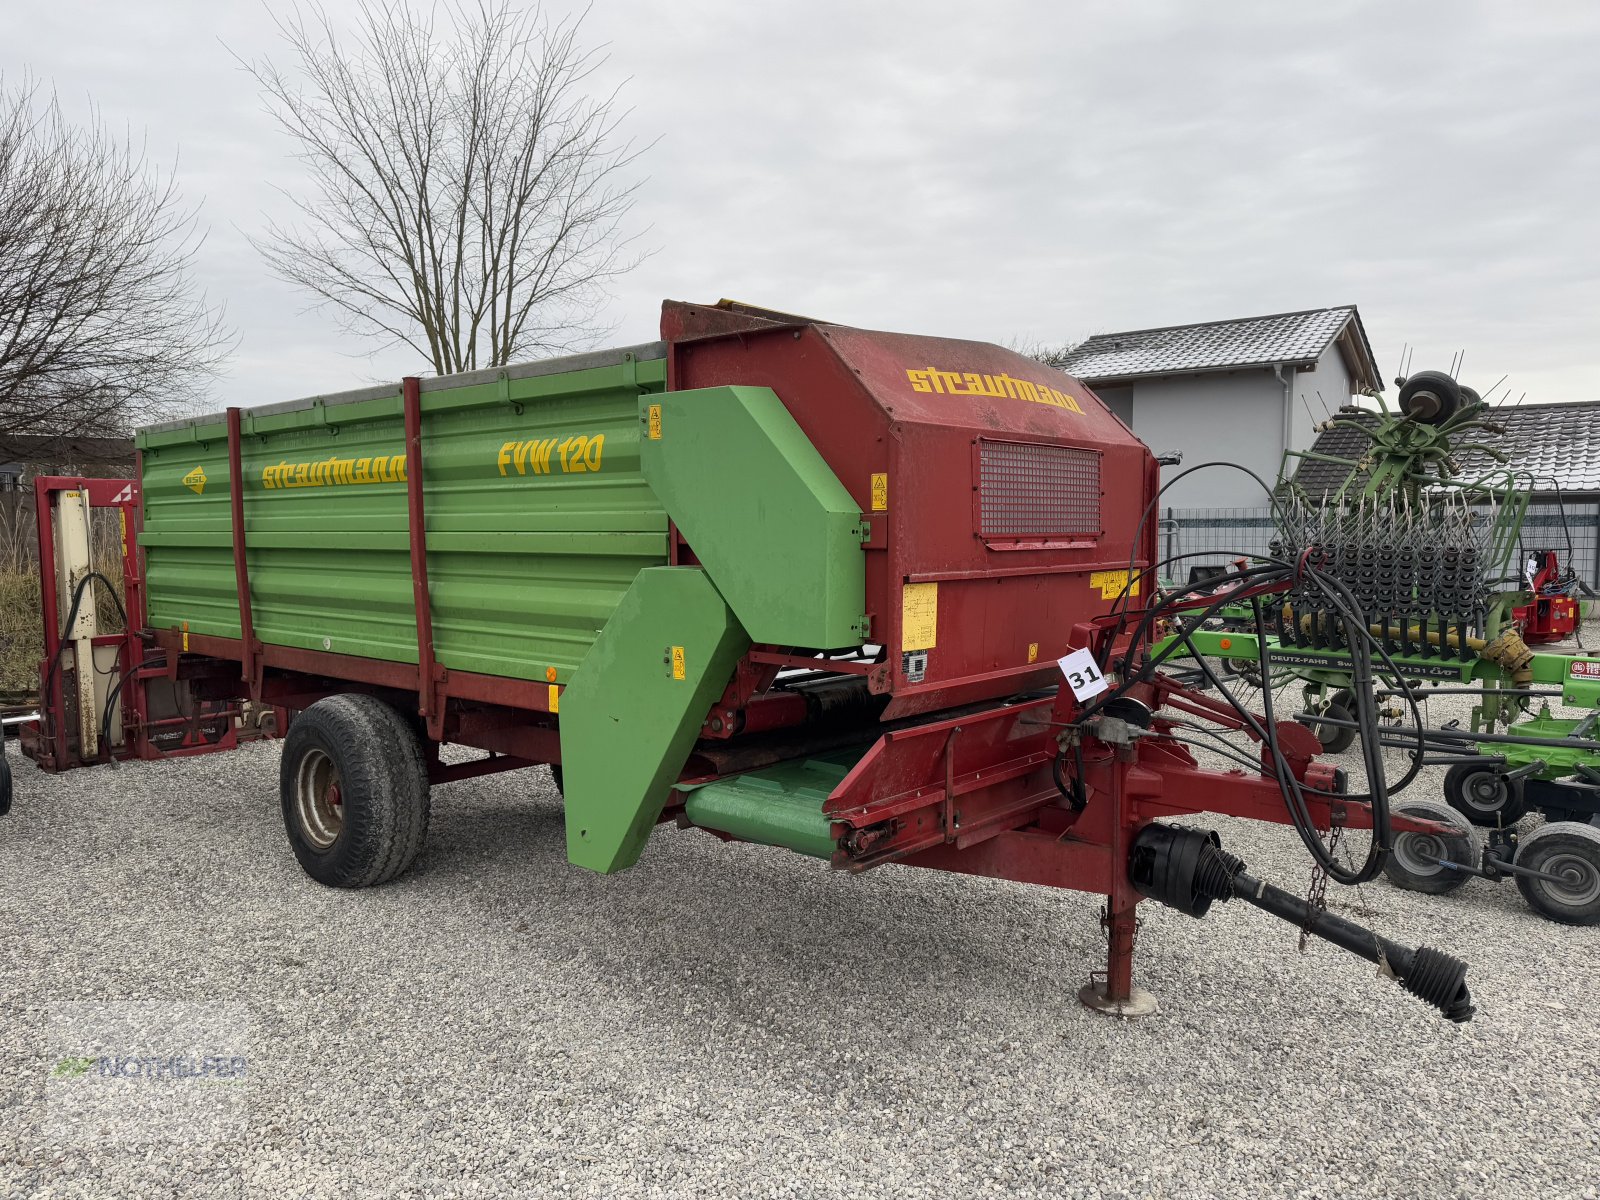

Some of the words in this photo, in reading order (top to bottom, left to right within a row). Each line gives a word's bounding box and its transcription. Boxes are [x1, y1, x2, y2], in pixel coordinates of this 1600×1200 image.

[906, 366, 1086, 415] strautmann
[498, 438, 558, 476] FVW
[557, 433, 605, 472] 120
[185, 474, 204, 485] BSL
[1068, 665, 1100, 690] 31
[1270, 655, 1328, 665] DEUTZ-FAHR
[1400, 666, 1426, 674] 7131
[1429, 667, 1458, 676] Evo
